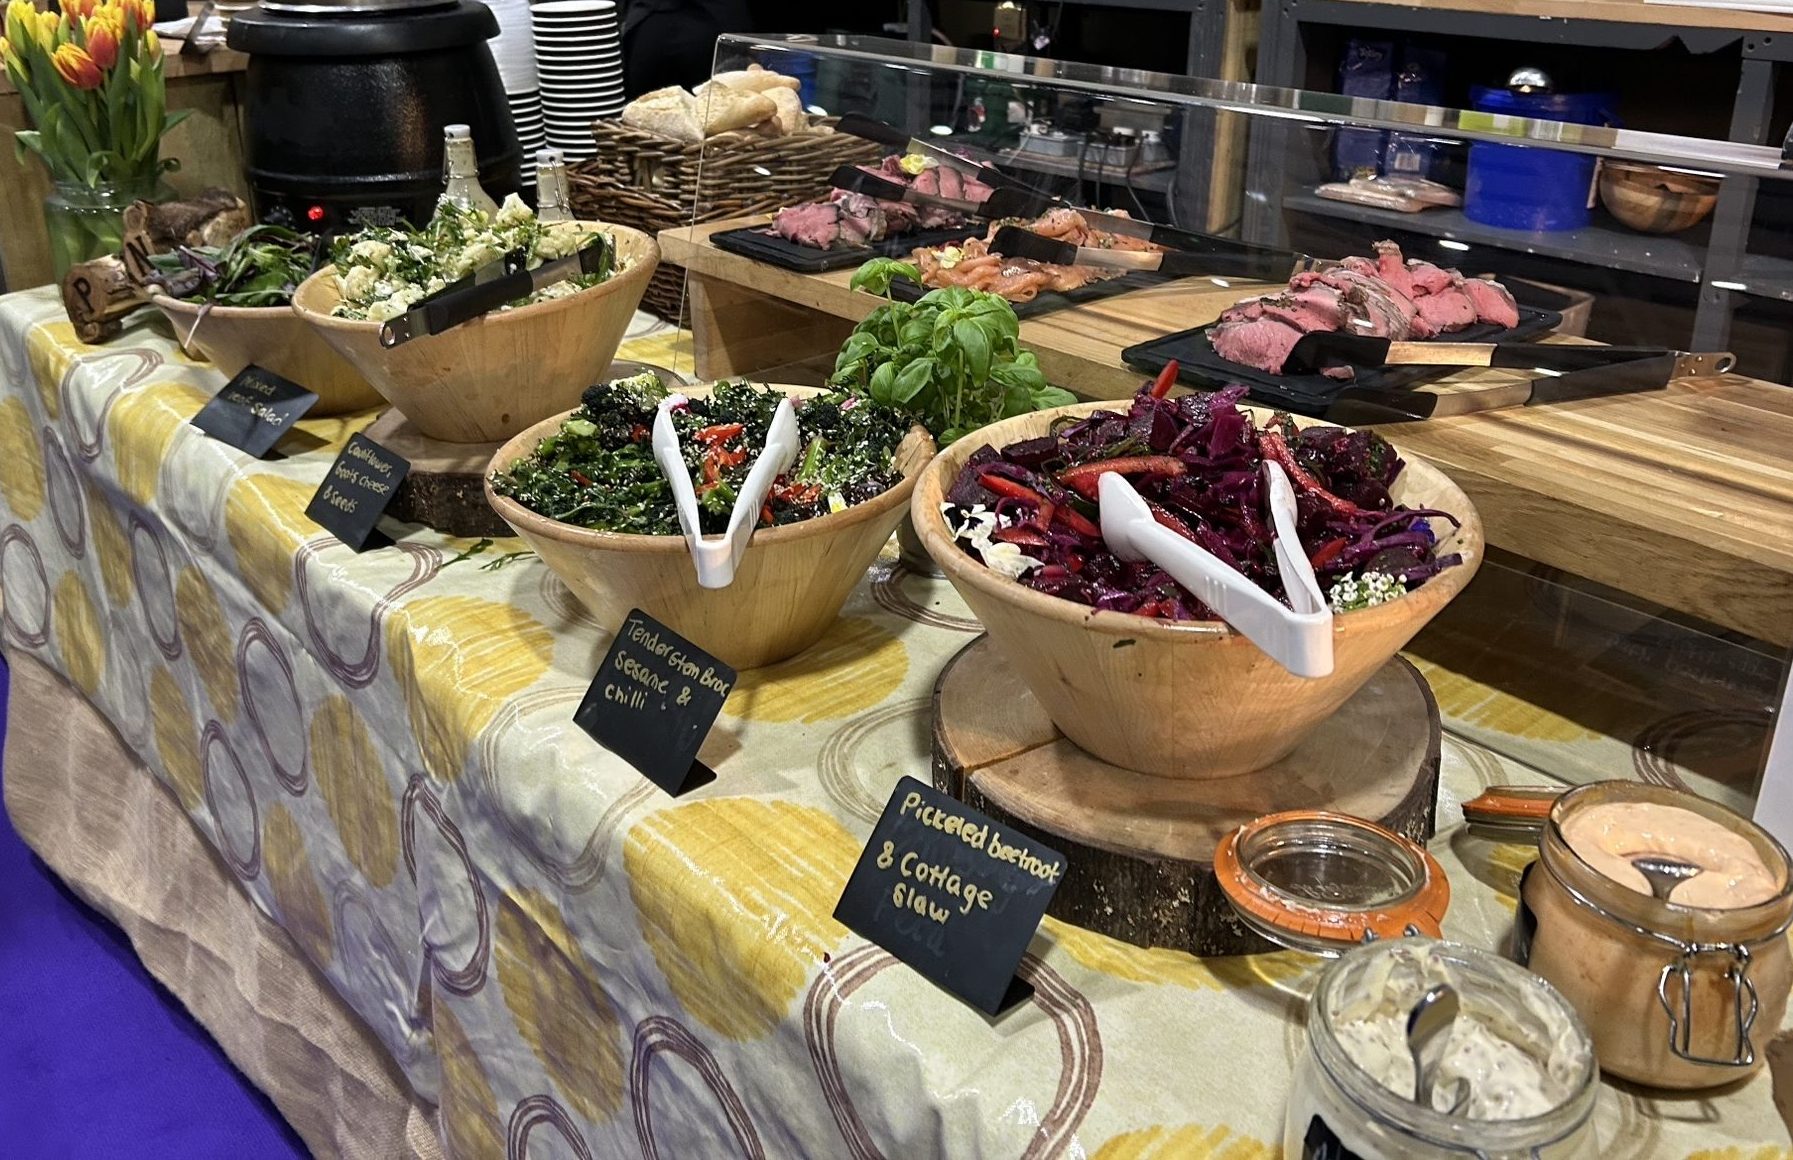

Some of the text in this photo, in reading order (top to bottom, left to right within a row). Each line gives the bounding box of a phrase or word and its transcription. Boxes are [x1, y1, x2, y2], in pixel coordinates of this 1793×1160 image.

[72, 277, 94, 314] P
[250, 402, 290, 426] Salad
[676, 686, 692, 707] &
[699, 667, 730, 698] Broc
[876, 840, 993, 915] & Cottage
